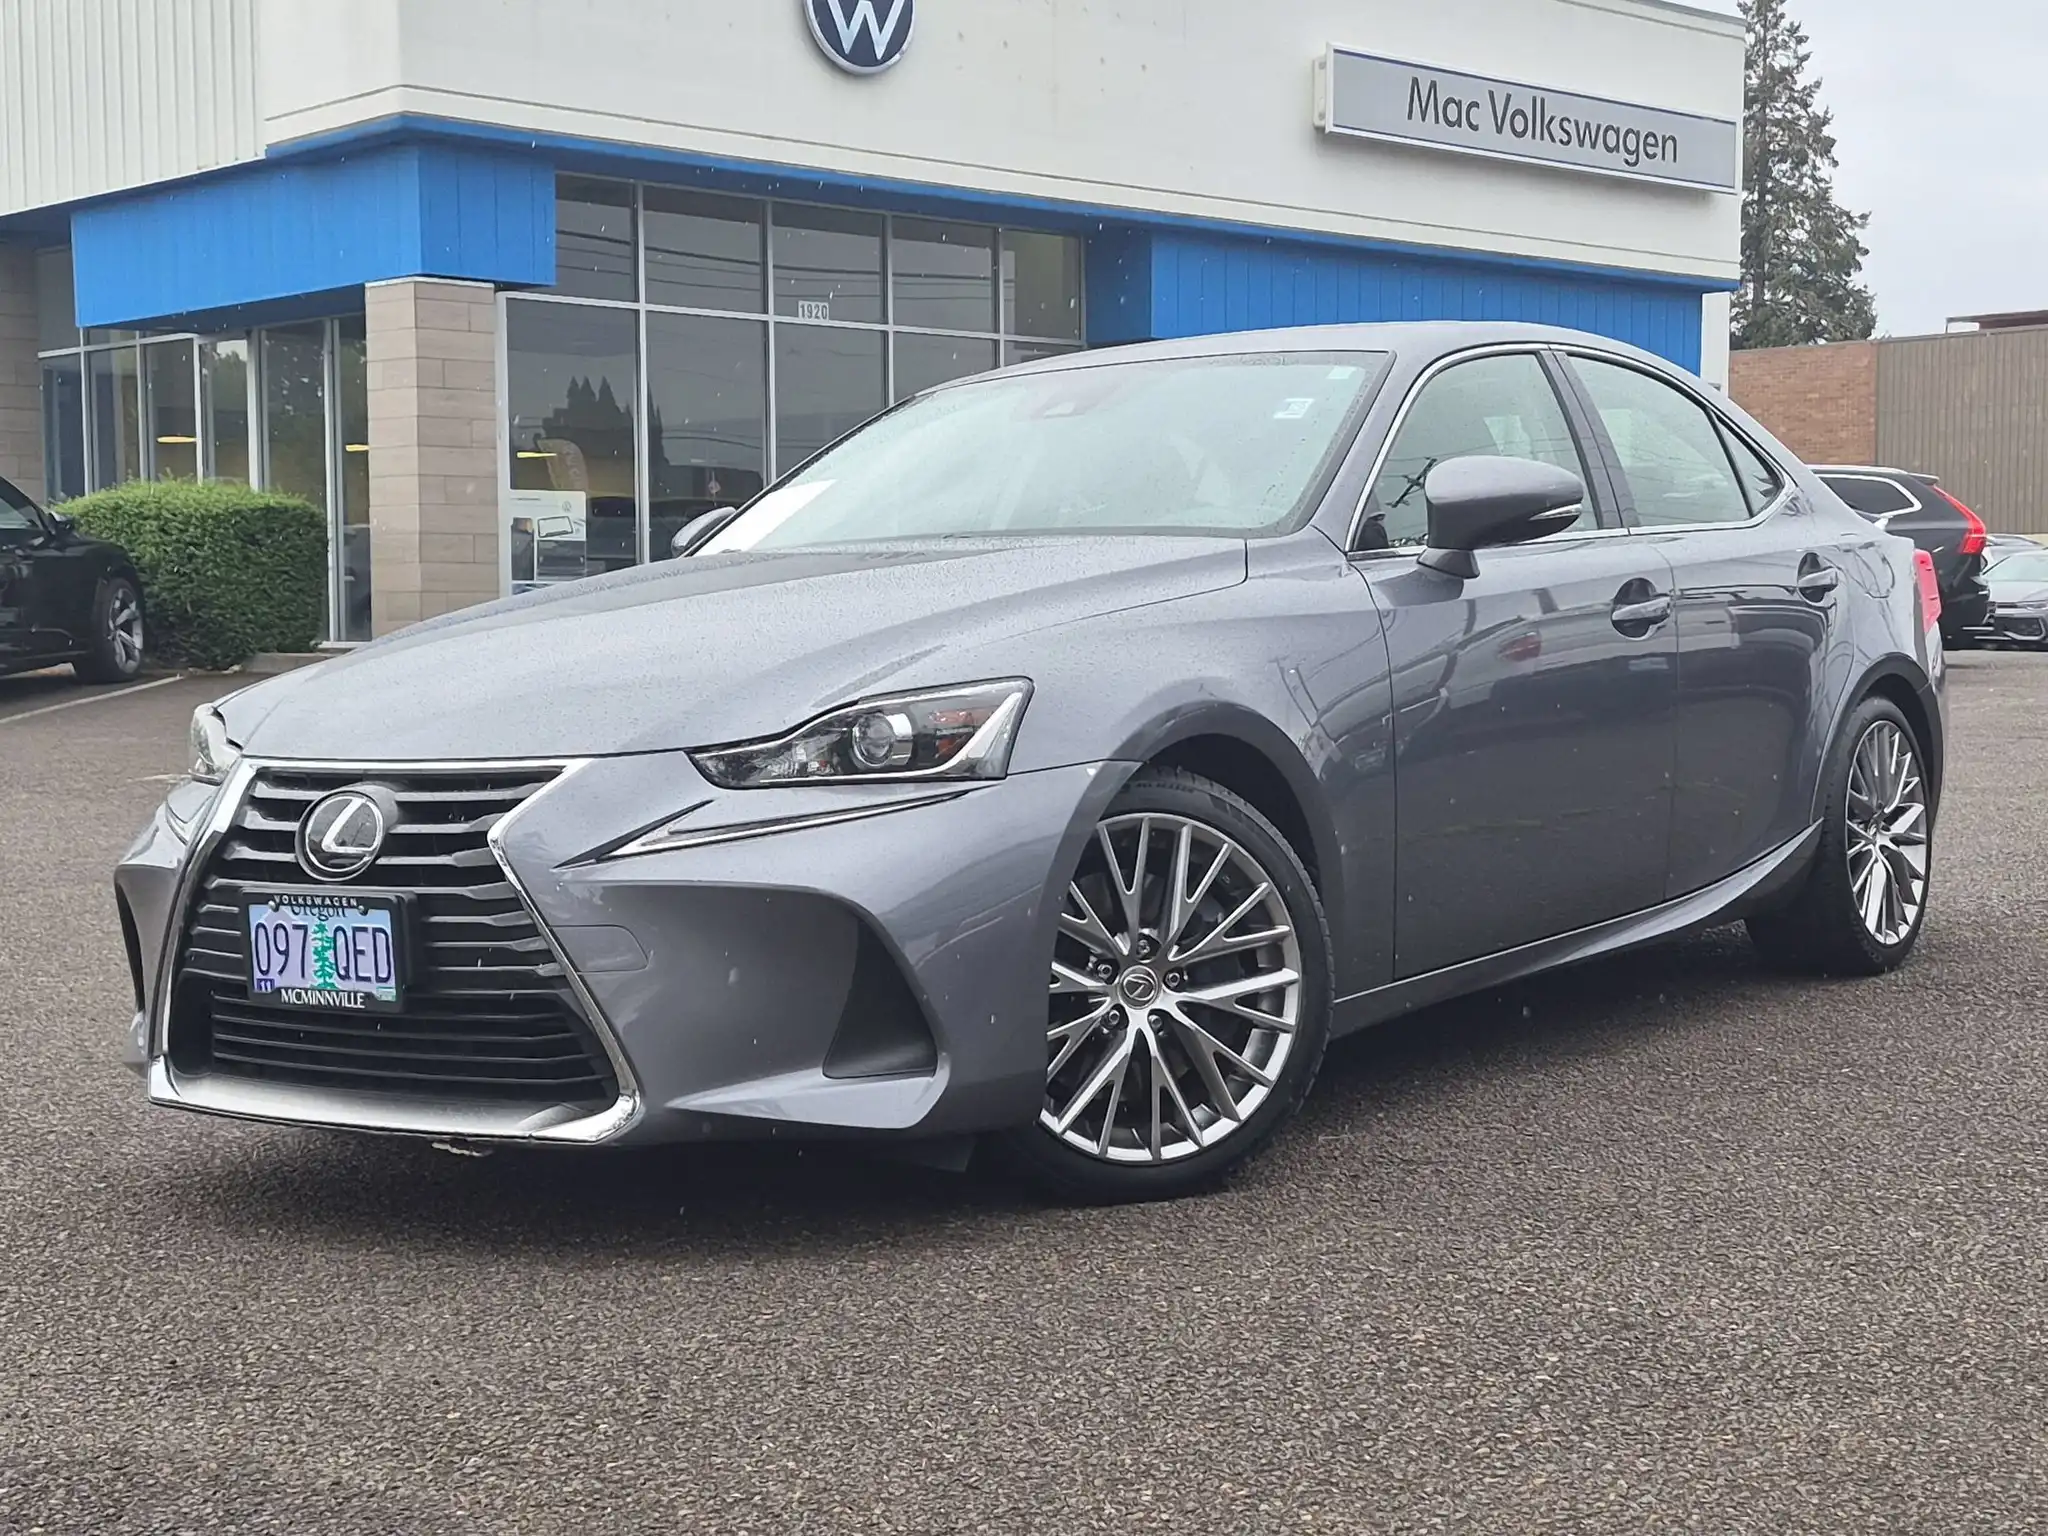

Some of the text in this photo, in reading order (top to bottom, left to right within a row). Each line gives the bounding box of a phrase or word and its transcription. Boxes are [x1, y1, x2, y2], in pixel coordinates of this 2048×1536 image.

[1407, 75, 1678, 167] Mac Volkswagen
[800, 303, 828, 320] 1920
[274, 895, 357, 907] VOLKSWAGEN
[254, 921, 392, 984] 097 QED
[281, 988, 365, 1009] MCMINNVILLE
